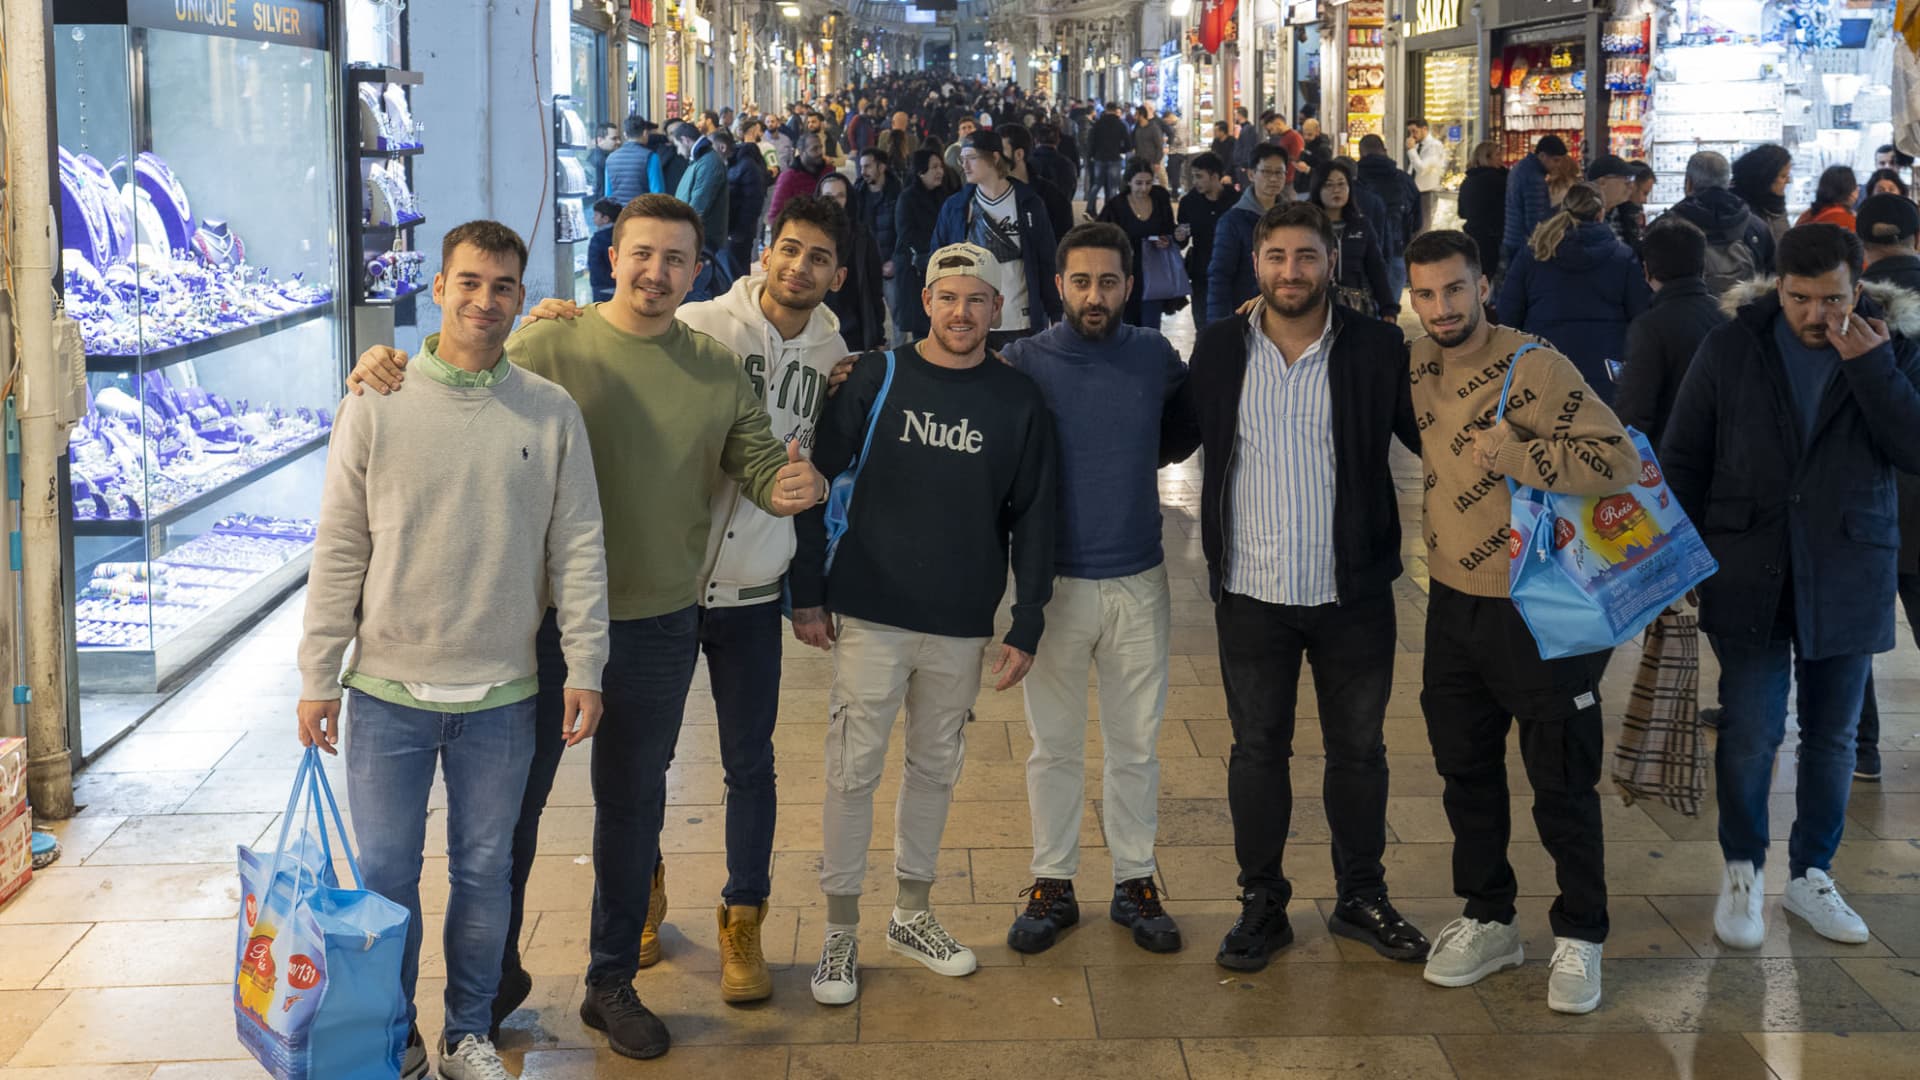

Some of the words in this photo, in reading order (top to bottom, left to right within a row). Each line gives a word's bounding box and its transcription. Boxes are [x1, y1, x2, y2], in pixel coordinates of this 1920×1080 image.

[175, 0, 237, 27] UNIQUE
[253, 2, 300, 35] SILVER
[1416, 0, 1459, 35] SARAY
[898, 409, 984, 454] Nude
[1600, 502, 1634, 526] Reis
